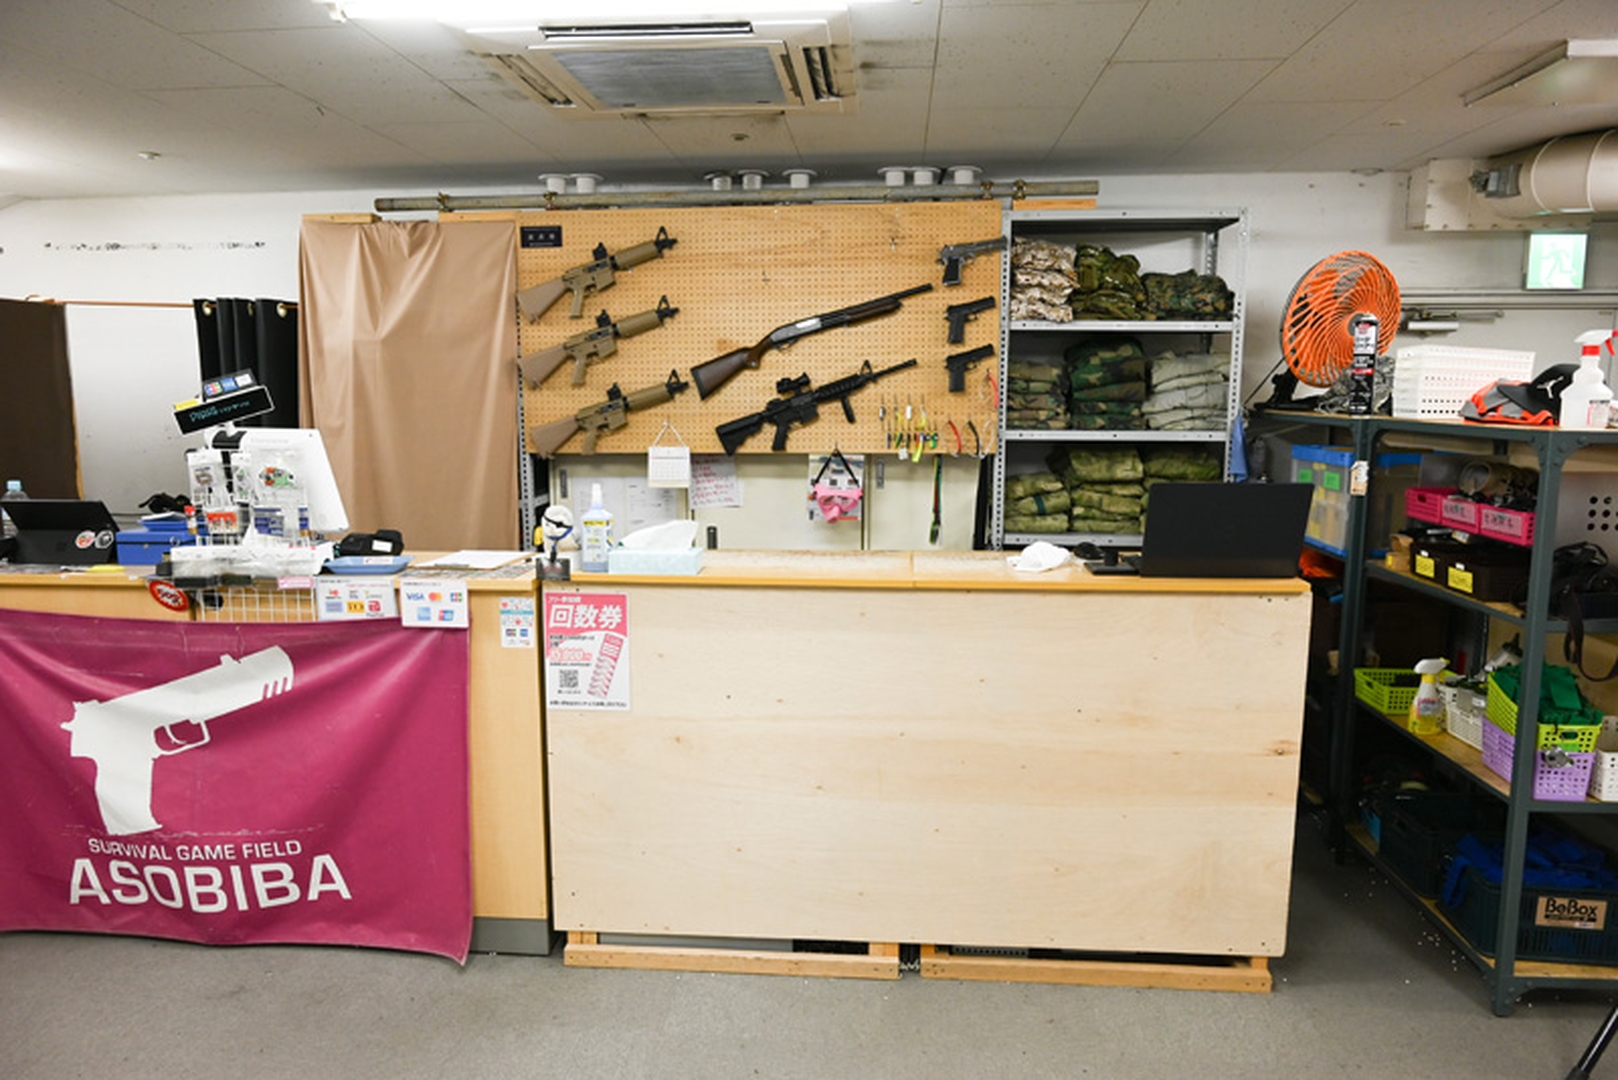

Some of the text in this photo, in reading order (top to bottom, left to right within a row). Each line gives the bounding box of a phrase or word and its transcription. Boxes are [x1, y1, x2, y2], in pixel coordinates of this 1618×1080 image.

[406, 592, 425, 601] VISA
[549, 604, 623, 629] 回数券
[88, 839, 302, 861] SURVIVAL GAME FIELD
[70, 854, 352, 913] ASOBIBA
